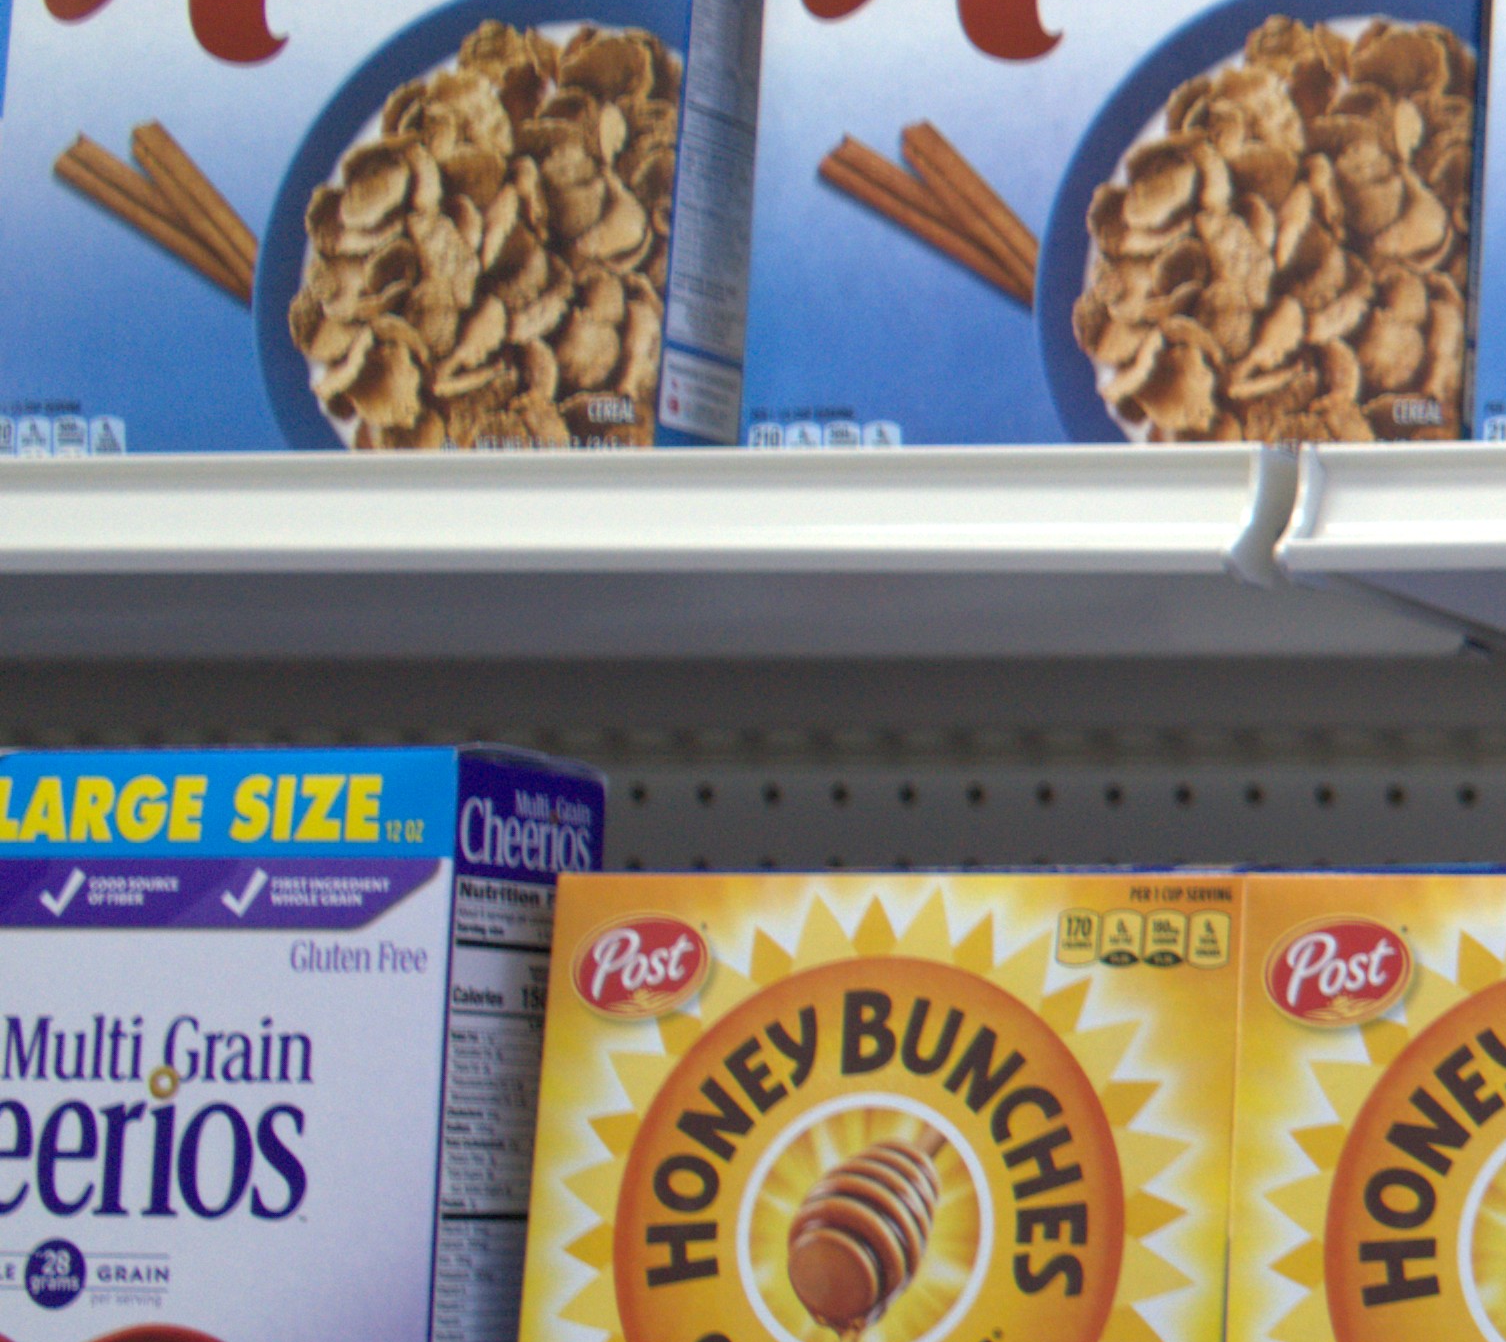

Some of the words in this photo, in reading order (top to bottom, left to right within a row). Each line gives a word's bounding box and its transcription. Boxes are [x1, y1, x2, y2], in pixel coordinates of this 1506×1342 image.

[0, 776, 207, 843] LARGE
[229, 774, 384, 843] SIZE
[386, 820, 401, 843] 12
[405, 820, 425, 843] OZ
[460, 795, 591, 873] Cheerios
[290, 941, 371, 974] Gluten
[379, 942, 428, 974] Free
[592, 927, 694, 1001] Post
[1287, 929, 1391, 1006] Post
[3, 1015, 142, 1083] Multi
[164, 1016, 314, 1084] Grain
[646, 1004, 820, 1290] HONEY
[840, 989, 1089, 1298] BUNCHES
[97, 1265, 170, 1283] GRAIN
